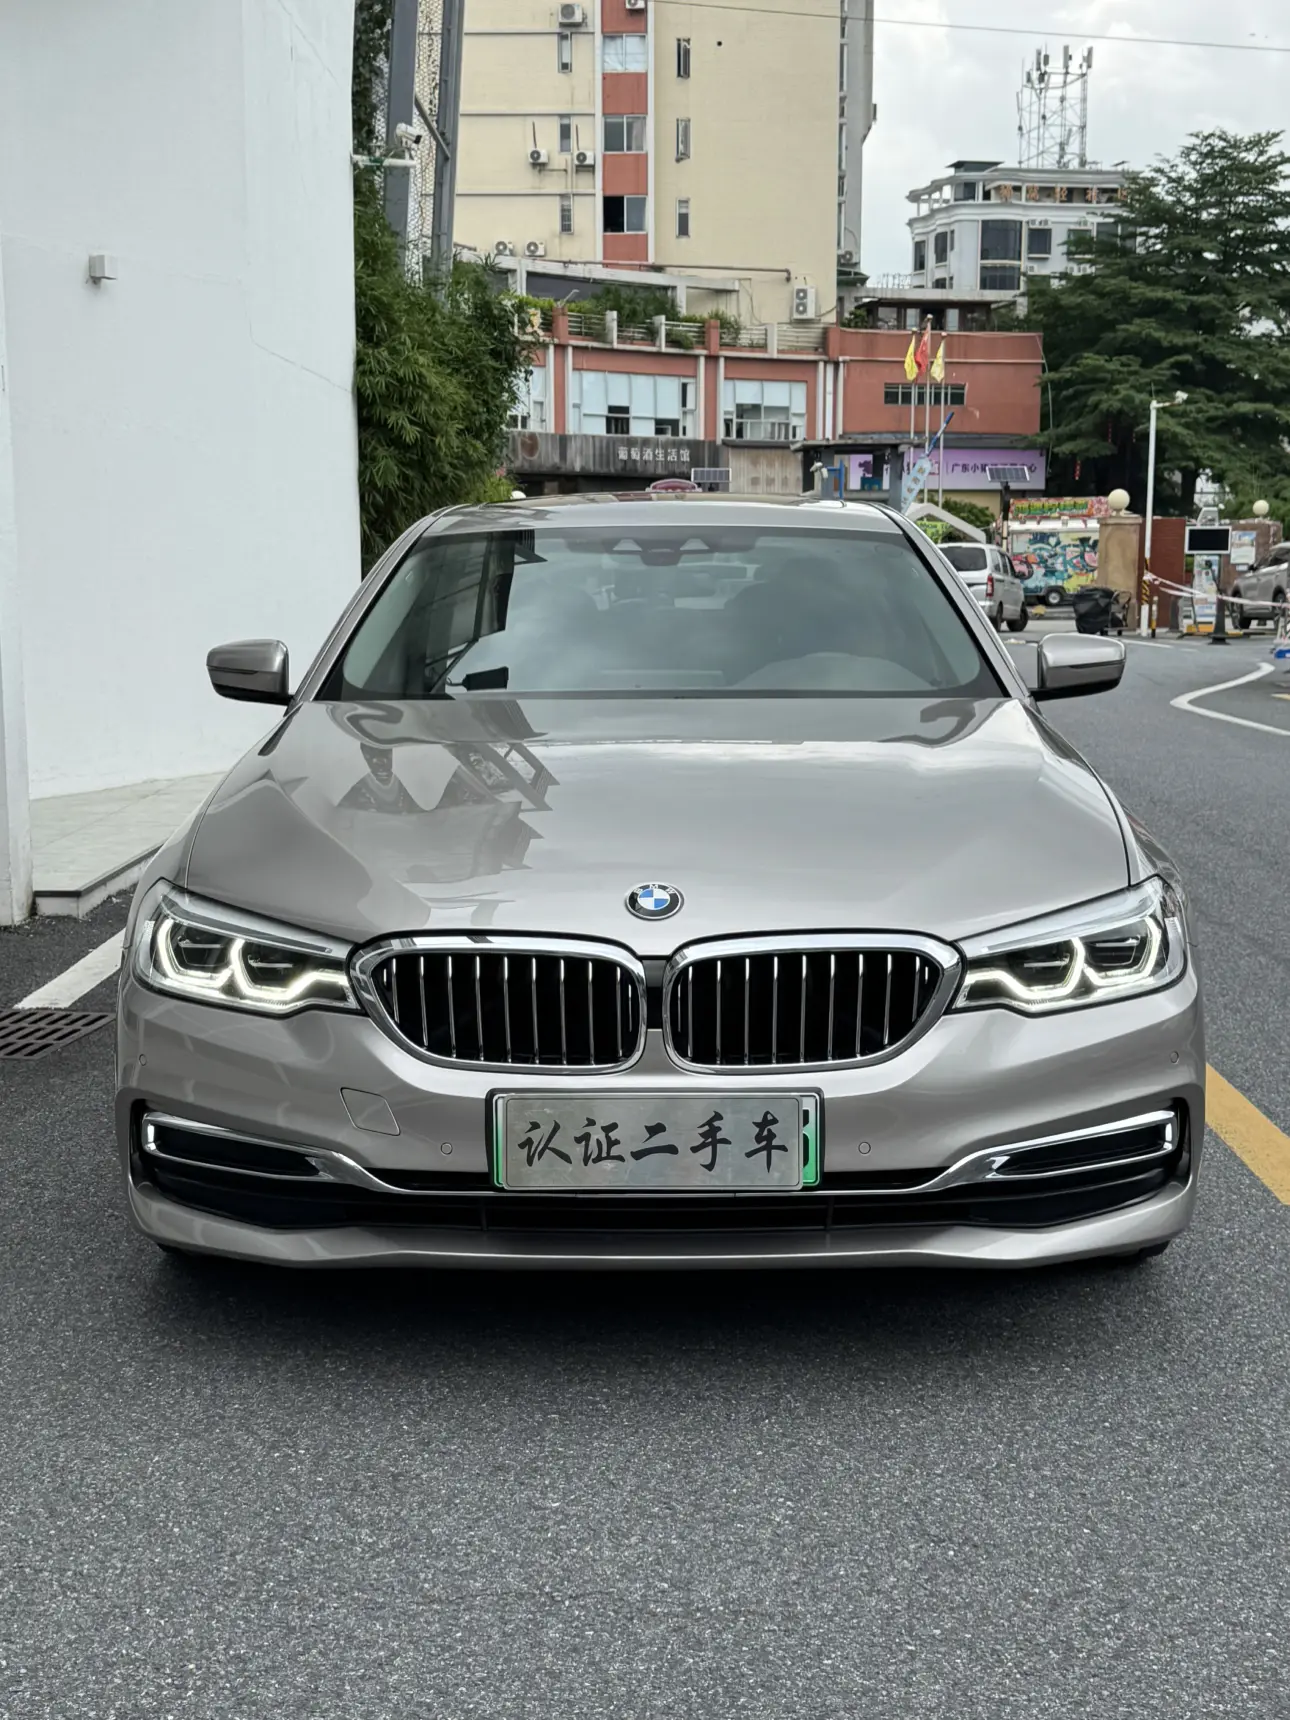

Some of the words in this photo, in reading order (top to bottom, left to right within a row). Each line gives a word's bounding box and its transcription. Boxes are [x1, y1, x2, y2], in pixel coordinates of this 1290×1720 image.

[617, 446, 690, 462] 葡萄酒生活馆
[632, 884, 676, 894] BMW
[517, 1110, 789, 1173] 认证二手车
